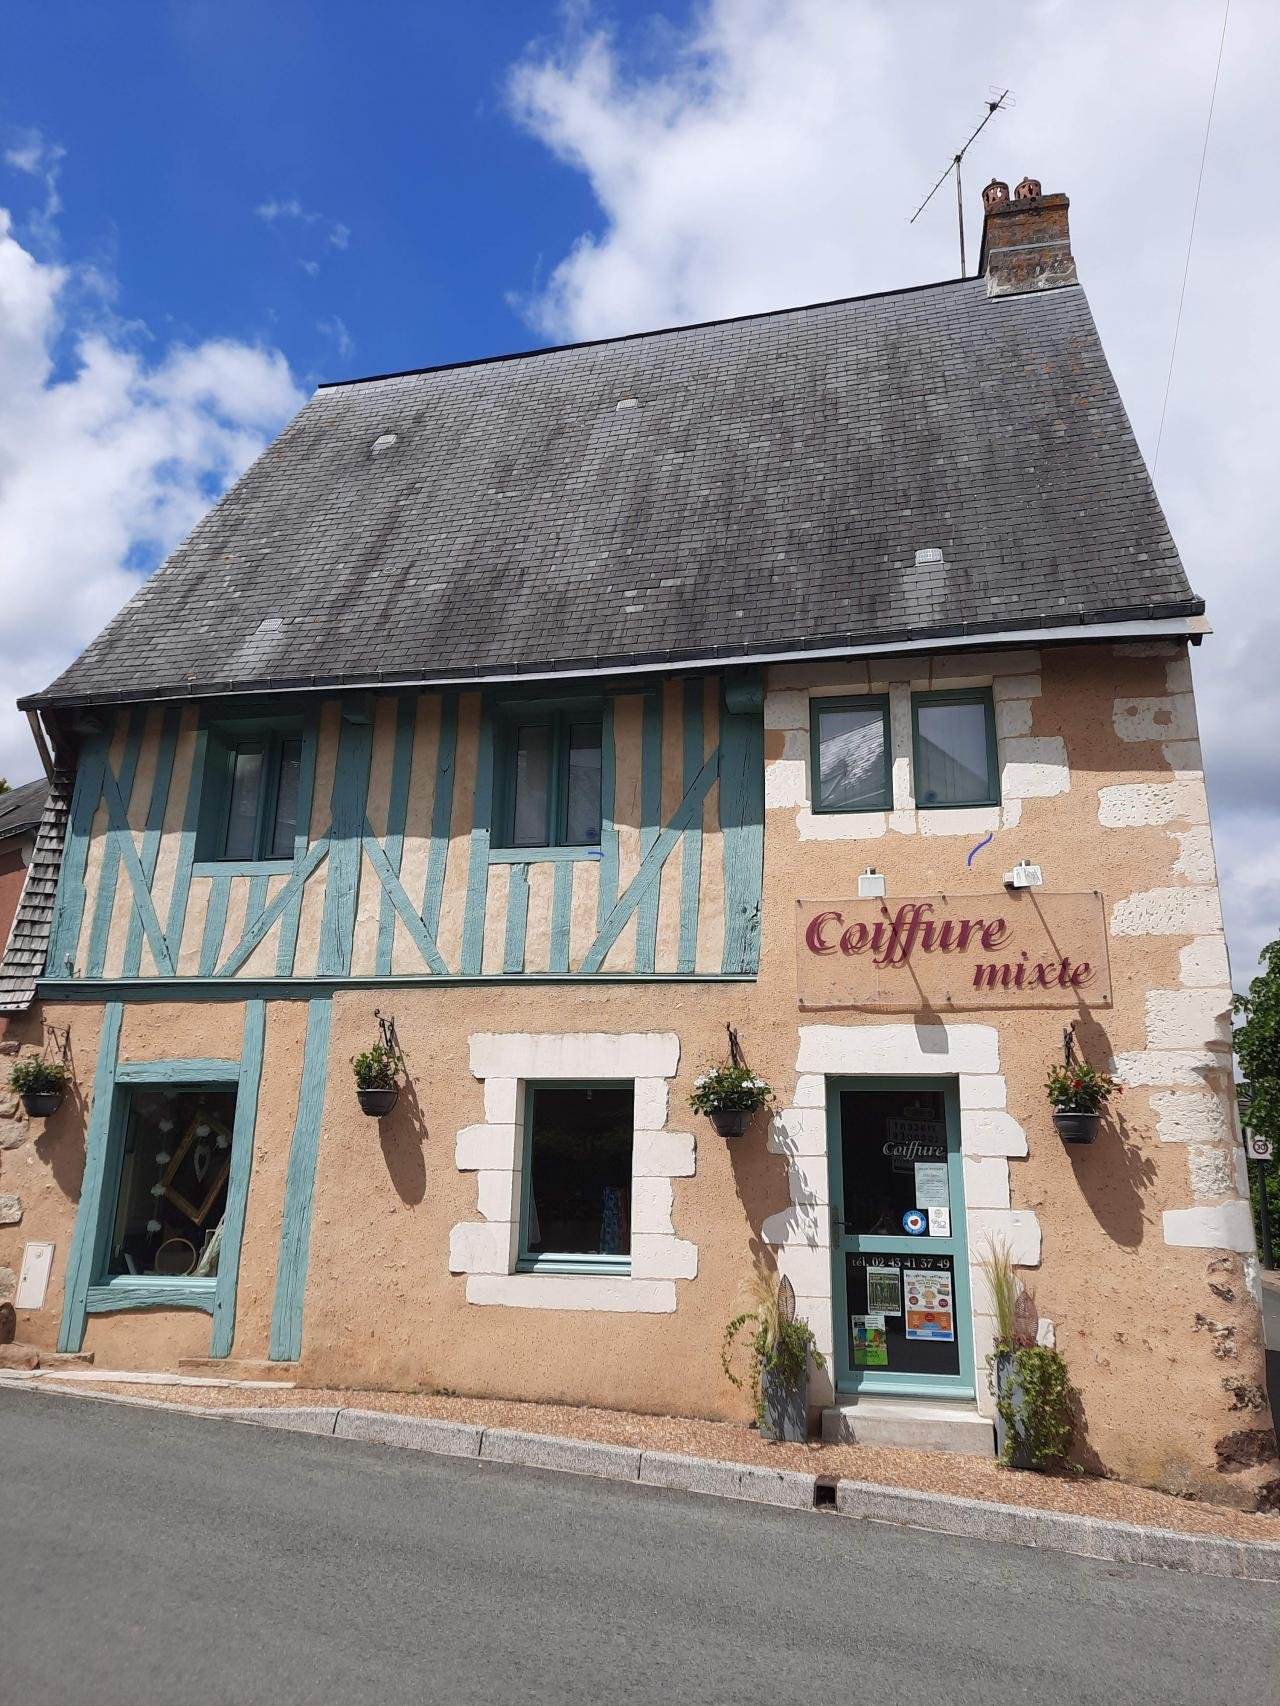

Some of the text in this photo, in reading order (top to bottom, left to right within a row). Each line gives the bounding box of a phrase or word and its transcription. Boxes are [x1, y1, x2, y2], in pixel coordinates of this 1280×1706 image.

[805, 903, 1012, 964] Coiffure
[972, 951, 1096, 988] mixte
[882, 1140, 945, 1160] Coiffure
[1256, 1143, 1266, 1151] 30
[852, 1256, 950, 1269] tél. 02 43 41 37 49
